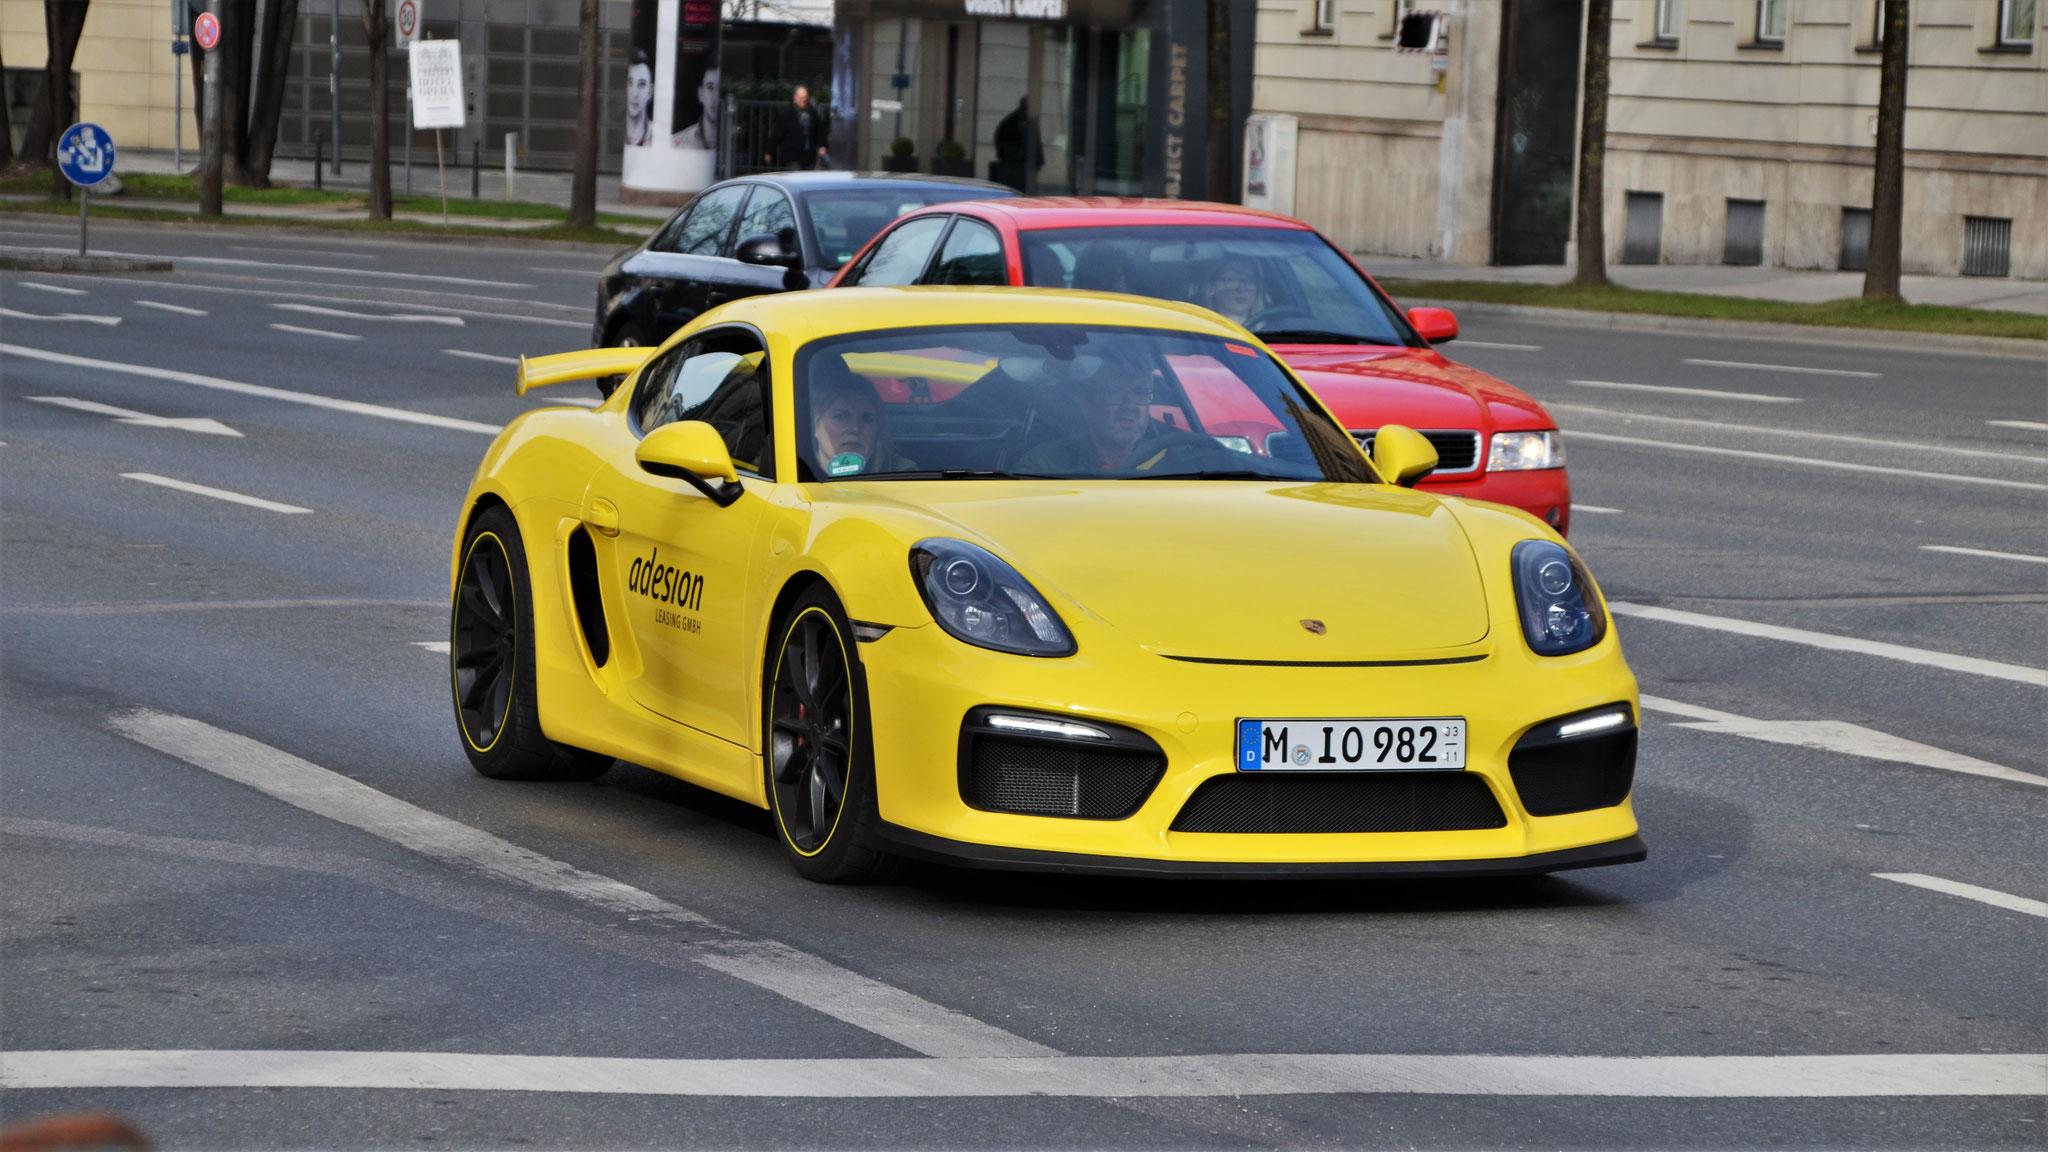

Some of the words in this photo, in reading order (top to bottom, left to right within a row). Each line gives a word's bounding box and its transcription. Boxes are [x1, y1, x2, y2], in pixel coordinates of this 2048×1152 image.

[402, 8, 413, 27] 30
[1168, 43, 1188, 127] CARPET
[1165, 133, 1183, 199] BJECT
[629, 547, 704, 611] adesion
[655, 608, 681, 629] LEASING
[682, 616, 702, 635] GMBH
[1246, 750, 1255, 762] D
[1263, 726, 1288, 763] M
[1373, 726, 1437, 763] 982
